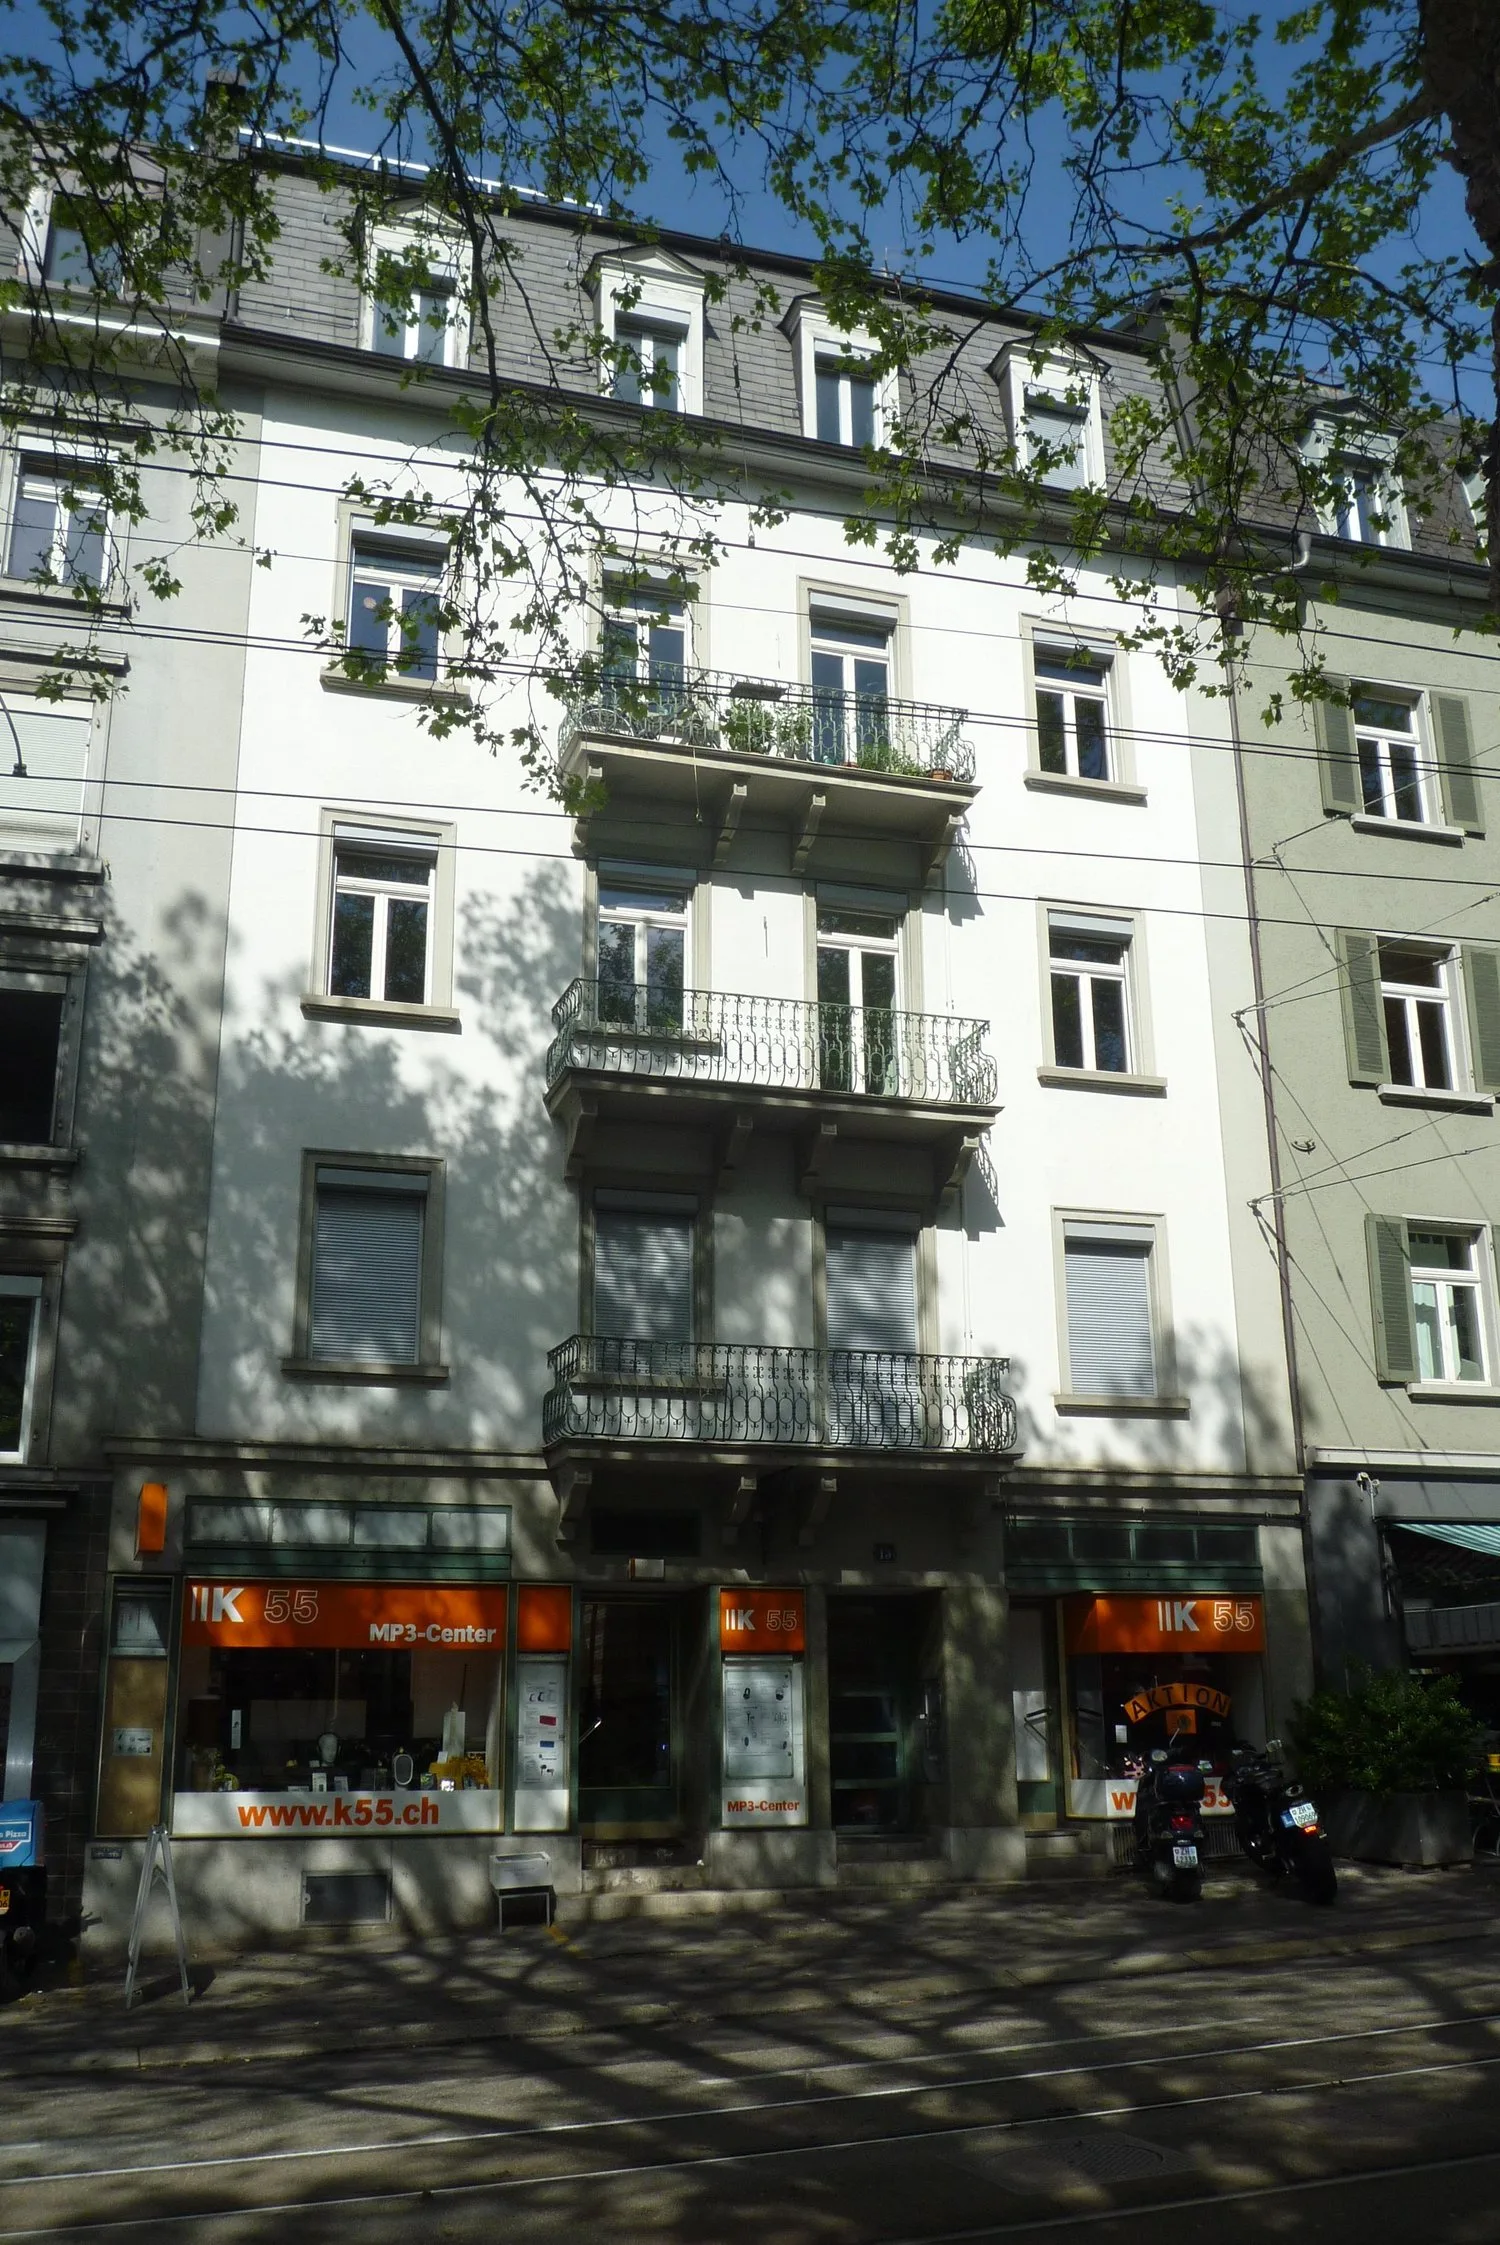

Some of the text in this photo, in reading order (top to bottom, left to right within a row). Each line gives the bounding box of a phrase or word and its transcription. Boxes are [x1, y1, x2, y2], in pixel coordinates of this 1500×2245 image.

[264, 1589, 319, 1624] 55
[766, 1610, 797, 1631] 55
[1213, 1601, 1255, 1632] 55
[369, 1623, 497, 1642] MP3-Center
[1131, 1686, 1228, 1719] AKTION
[238, 1797, 439, 1827] www.k55.ch
[727, 1801, 800, 1812] MP3-Center
